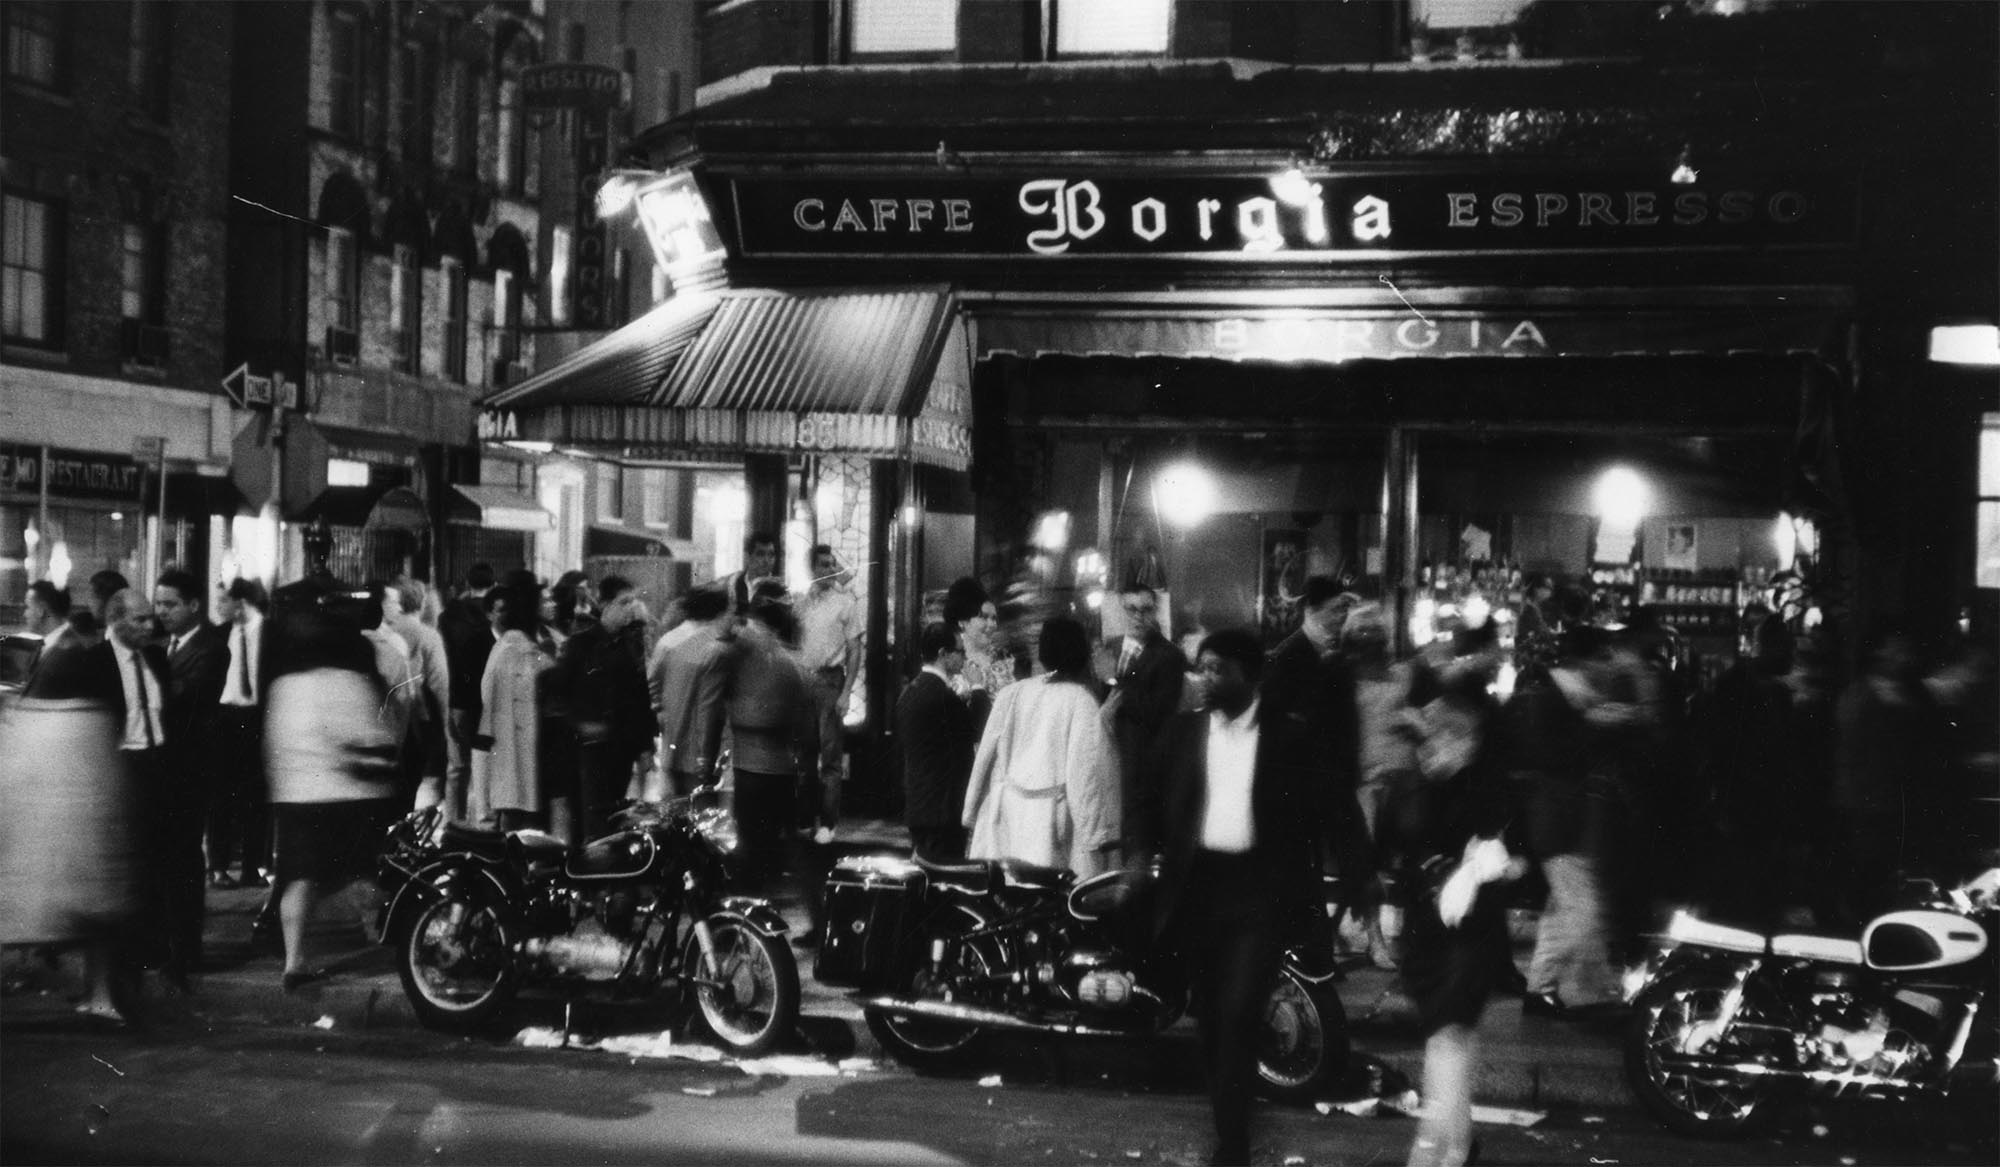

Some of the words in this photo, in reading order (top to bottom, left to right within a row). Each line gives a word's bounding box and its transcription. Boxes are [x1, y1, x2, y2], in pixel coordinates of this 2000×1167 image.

[793, 198, 974, 232] CAFFE
[1018, 178, 1391, 254] Borgia
[1446, 191, 1808, 227] ESPRESSO
[1214, 319, 1546, 349] BORGIA
